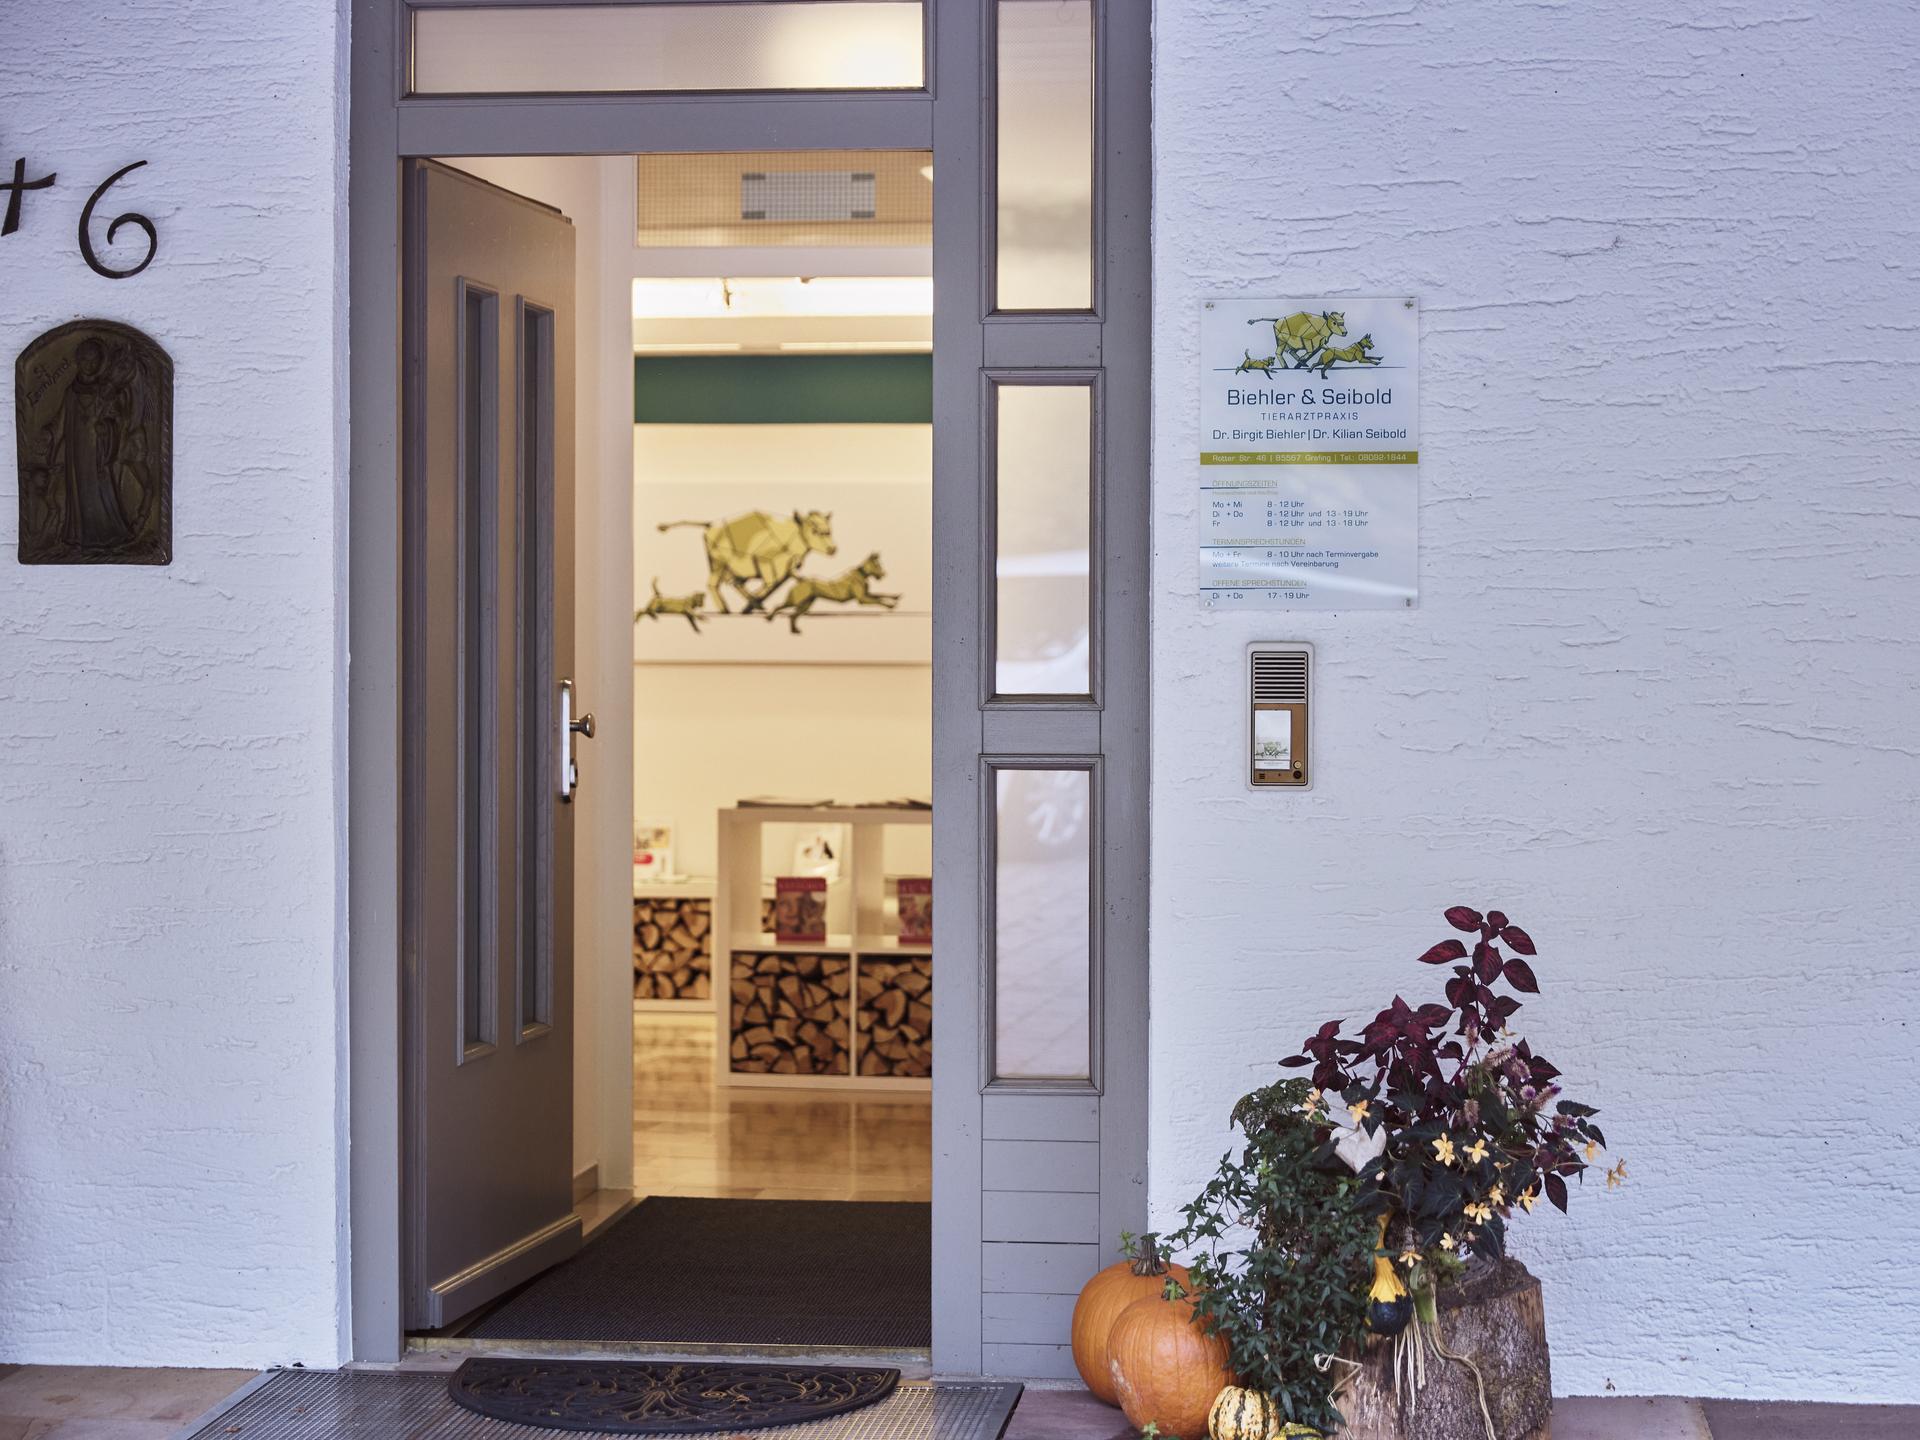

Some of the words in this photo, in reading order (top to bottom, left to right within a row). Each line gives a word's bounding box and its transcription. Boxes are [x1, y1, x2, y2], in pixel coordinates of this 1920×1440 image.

[1227, 389, 1295, 405] Biehler
[1301, 389, 1316, 405] &
[1322, 388, 1392, 405] Seibold
[1260, 412, 1359, 421] TIERARZTPRAXIS
[1212, 429, 1230, 440] Dr.
[1232, 429, 1264, 442] Birgit
[1266, 429, 1306, 440] Biehler
[1312, 429, 1330, 440] Dr.
[1332, 429, 1363, 440] Kilian
[1365, 429, 1407, 440] Seibold
[1212, 538, 1306, 546] TERMINSPRECHSTUNDEN
[1325, 551, 1379, 559] Terminvergabe
[1290, 560, 1339, 569] Vereinbarung
[1212, 592, 1220, 600] Di
[1233, 592, 1244, 600] Do
[1267, 592, 1277, 600] 17
[1284, 592, 1294, 600] 19
[1295, 592, 1310, 600] Uhr
